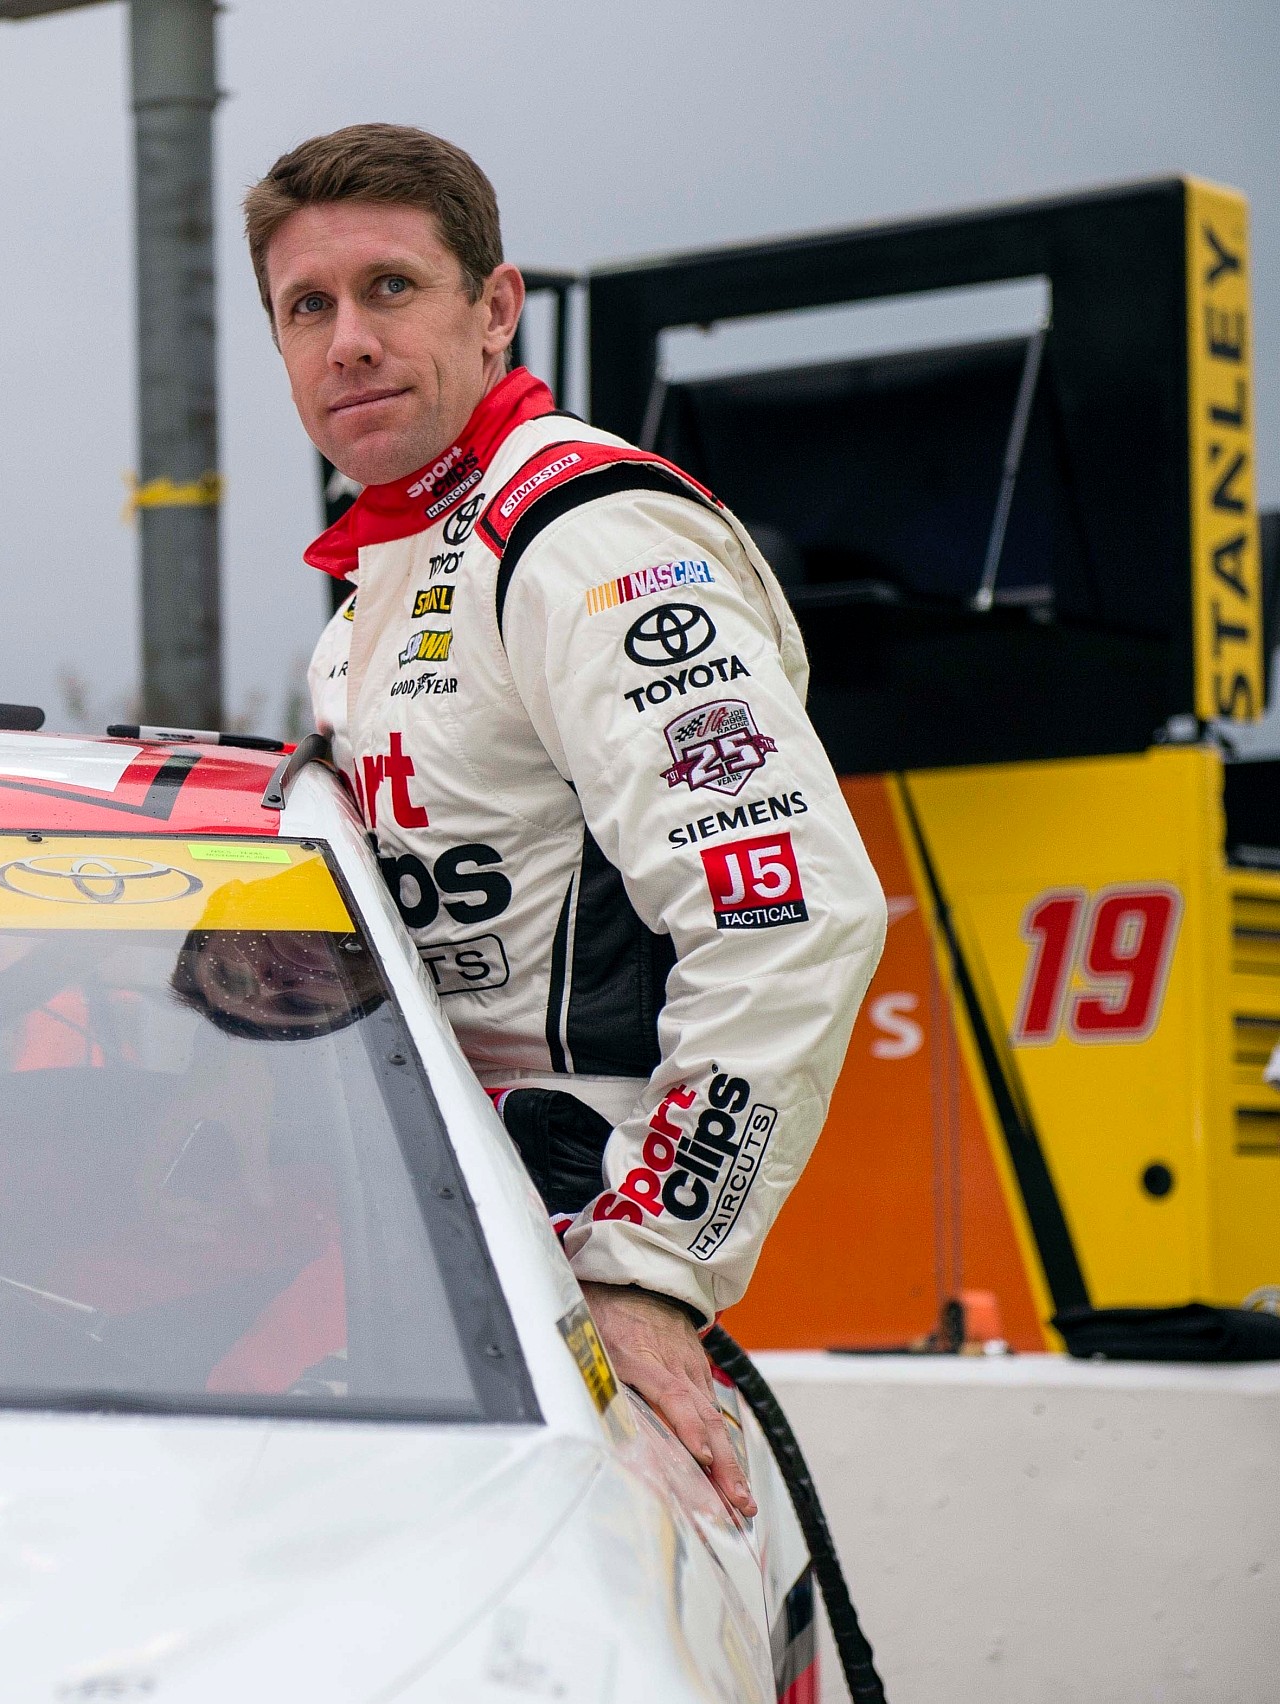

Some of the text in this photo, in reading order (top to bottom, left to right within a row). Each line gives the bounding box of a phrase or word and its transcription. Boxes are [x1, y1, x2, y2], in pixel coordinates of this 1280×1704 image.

[428, 471, 481, 517] HAIRCUTS
[504, 456, 574, 512] SIMPSON
[1202, 226, 1253, 718] STANLEY
[630, 560, 710, 598] NASCAR
[624, 655, 751, 714] TOYOTA
[682, 728, 765, 790] 25
[716, 772, 743, 787] YEARS
[668, 791, 808, 850] SIEMENS
[720, 845, 792, 906] J5
[721, 908, 803, 926] TACTICAL
[1016, 882, 1184, 1046] 19
[696, 1112, 771, 1255] HAIRCUTS
